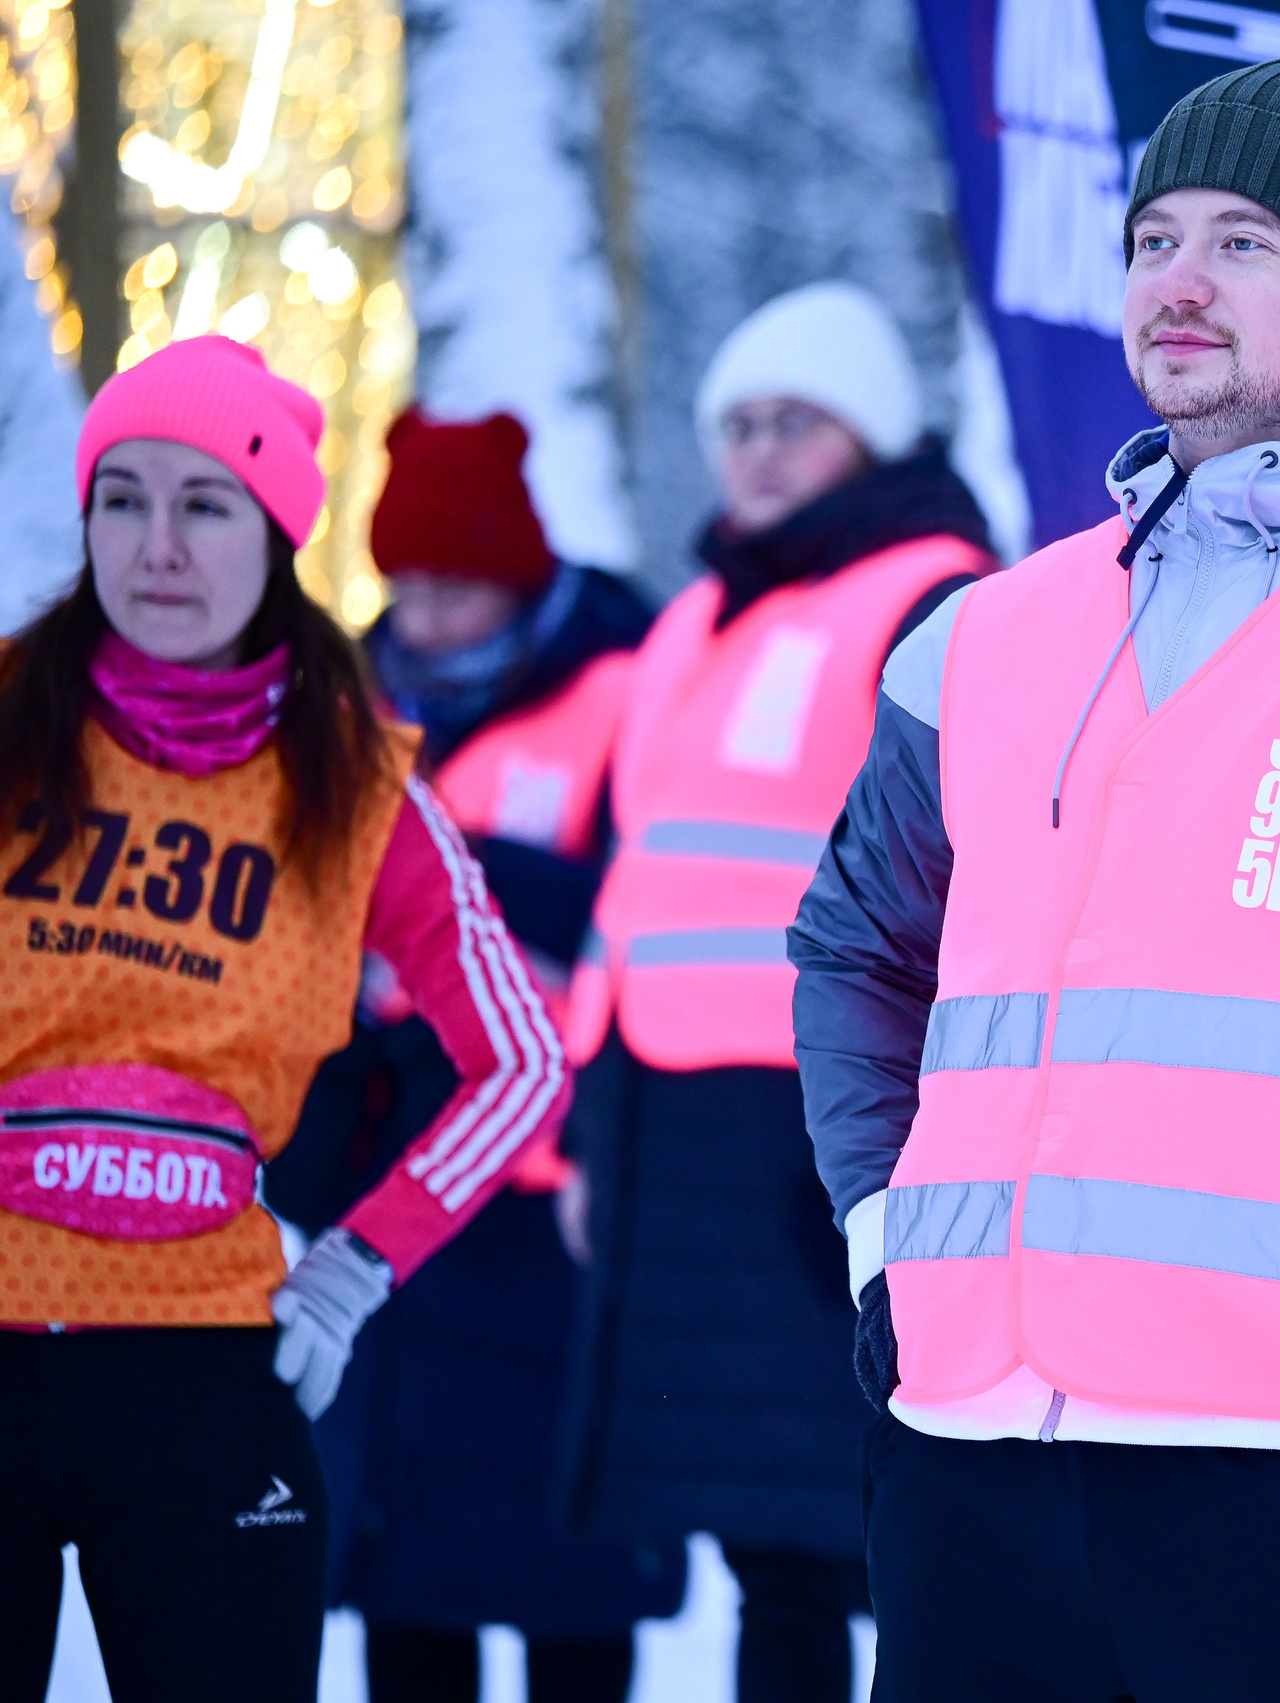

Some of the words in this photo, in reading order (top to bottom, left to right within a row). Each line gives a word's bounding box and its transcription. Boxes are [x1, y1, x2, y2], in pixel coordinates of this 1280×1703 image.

[4, 800, 276, 944] 27:30
[27, 915, 97, 957] 5:30
[33, 1141, 229, 1210] СУББОТА
